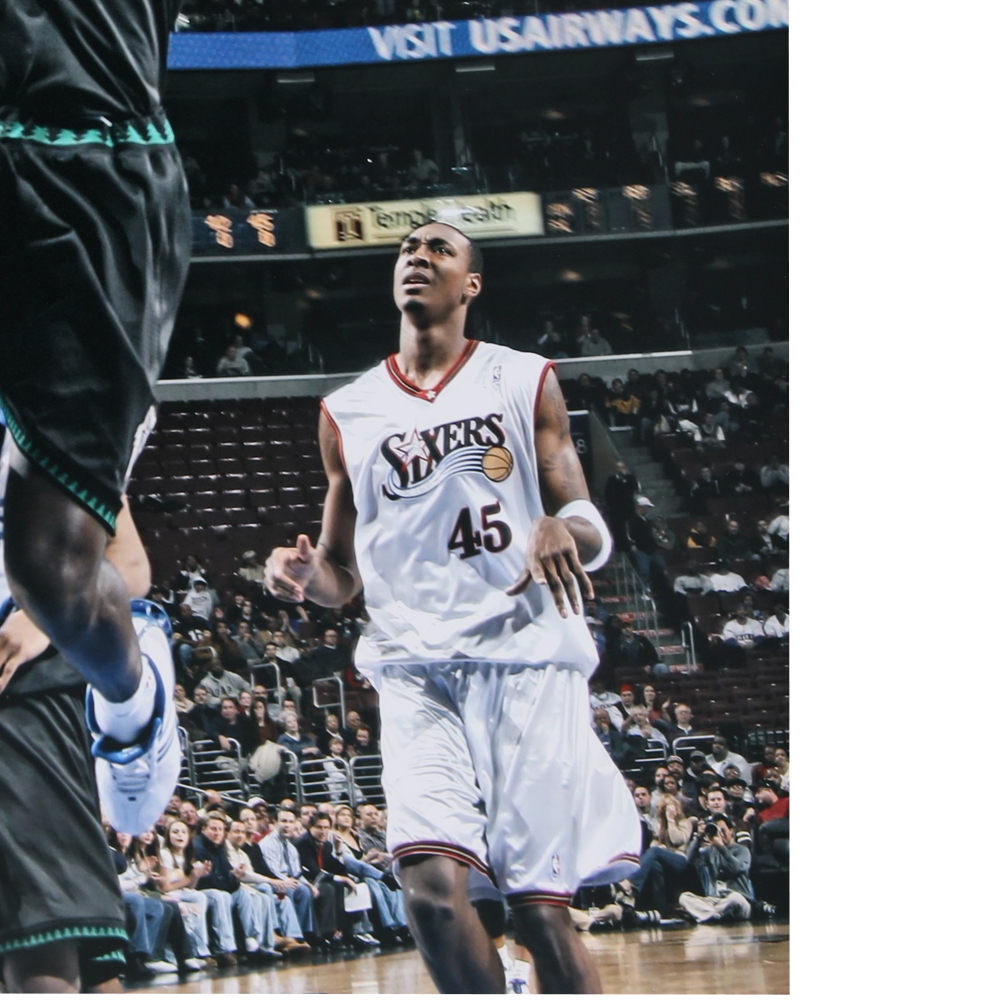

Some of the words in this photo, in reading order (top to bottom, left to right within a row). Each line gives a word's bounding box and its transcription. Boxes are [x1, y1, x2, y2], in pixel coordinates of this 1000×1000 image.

[367, 22, 456, 61] VISIT
[381, 413, 506, 500] SIXERS
[448, 500, 512, 560] 45
